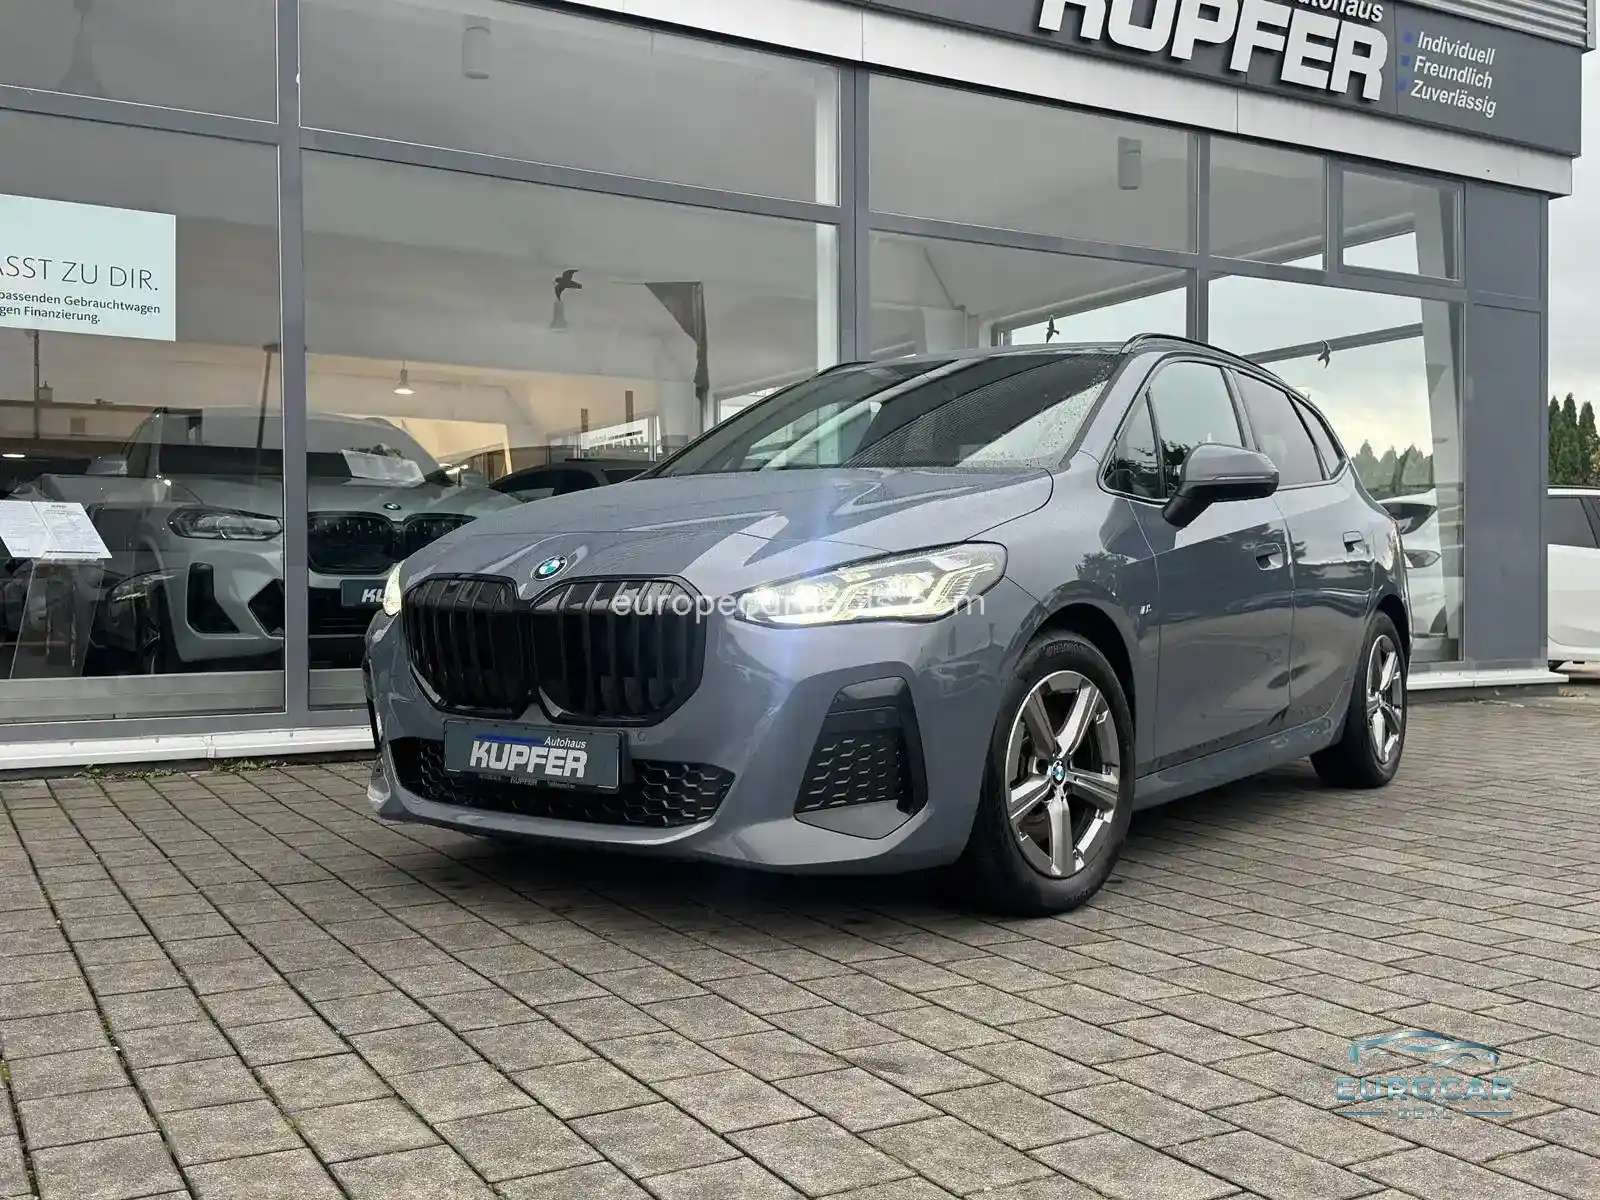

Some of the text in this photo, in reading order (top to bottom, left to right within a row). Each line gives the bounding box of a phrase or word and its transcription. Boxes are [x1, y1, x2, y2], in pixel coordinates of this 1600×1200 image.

[1417, 31, 1496, 65] Individuell
[1414, 55, 1493, 89] Freundlich
[1410, 79, 1497, 119] Zuverlässig
[0, 255, 158, 291] SST ZU DIR.
[24, 306, 100, 324] Finanzierung.
[64, 295, 160, 314] Gebrauchtwagen
[470, 741, 587, 777] KUPFER
[544, 736, 587, 749] Autohaus
